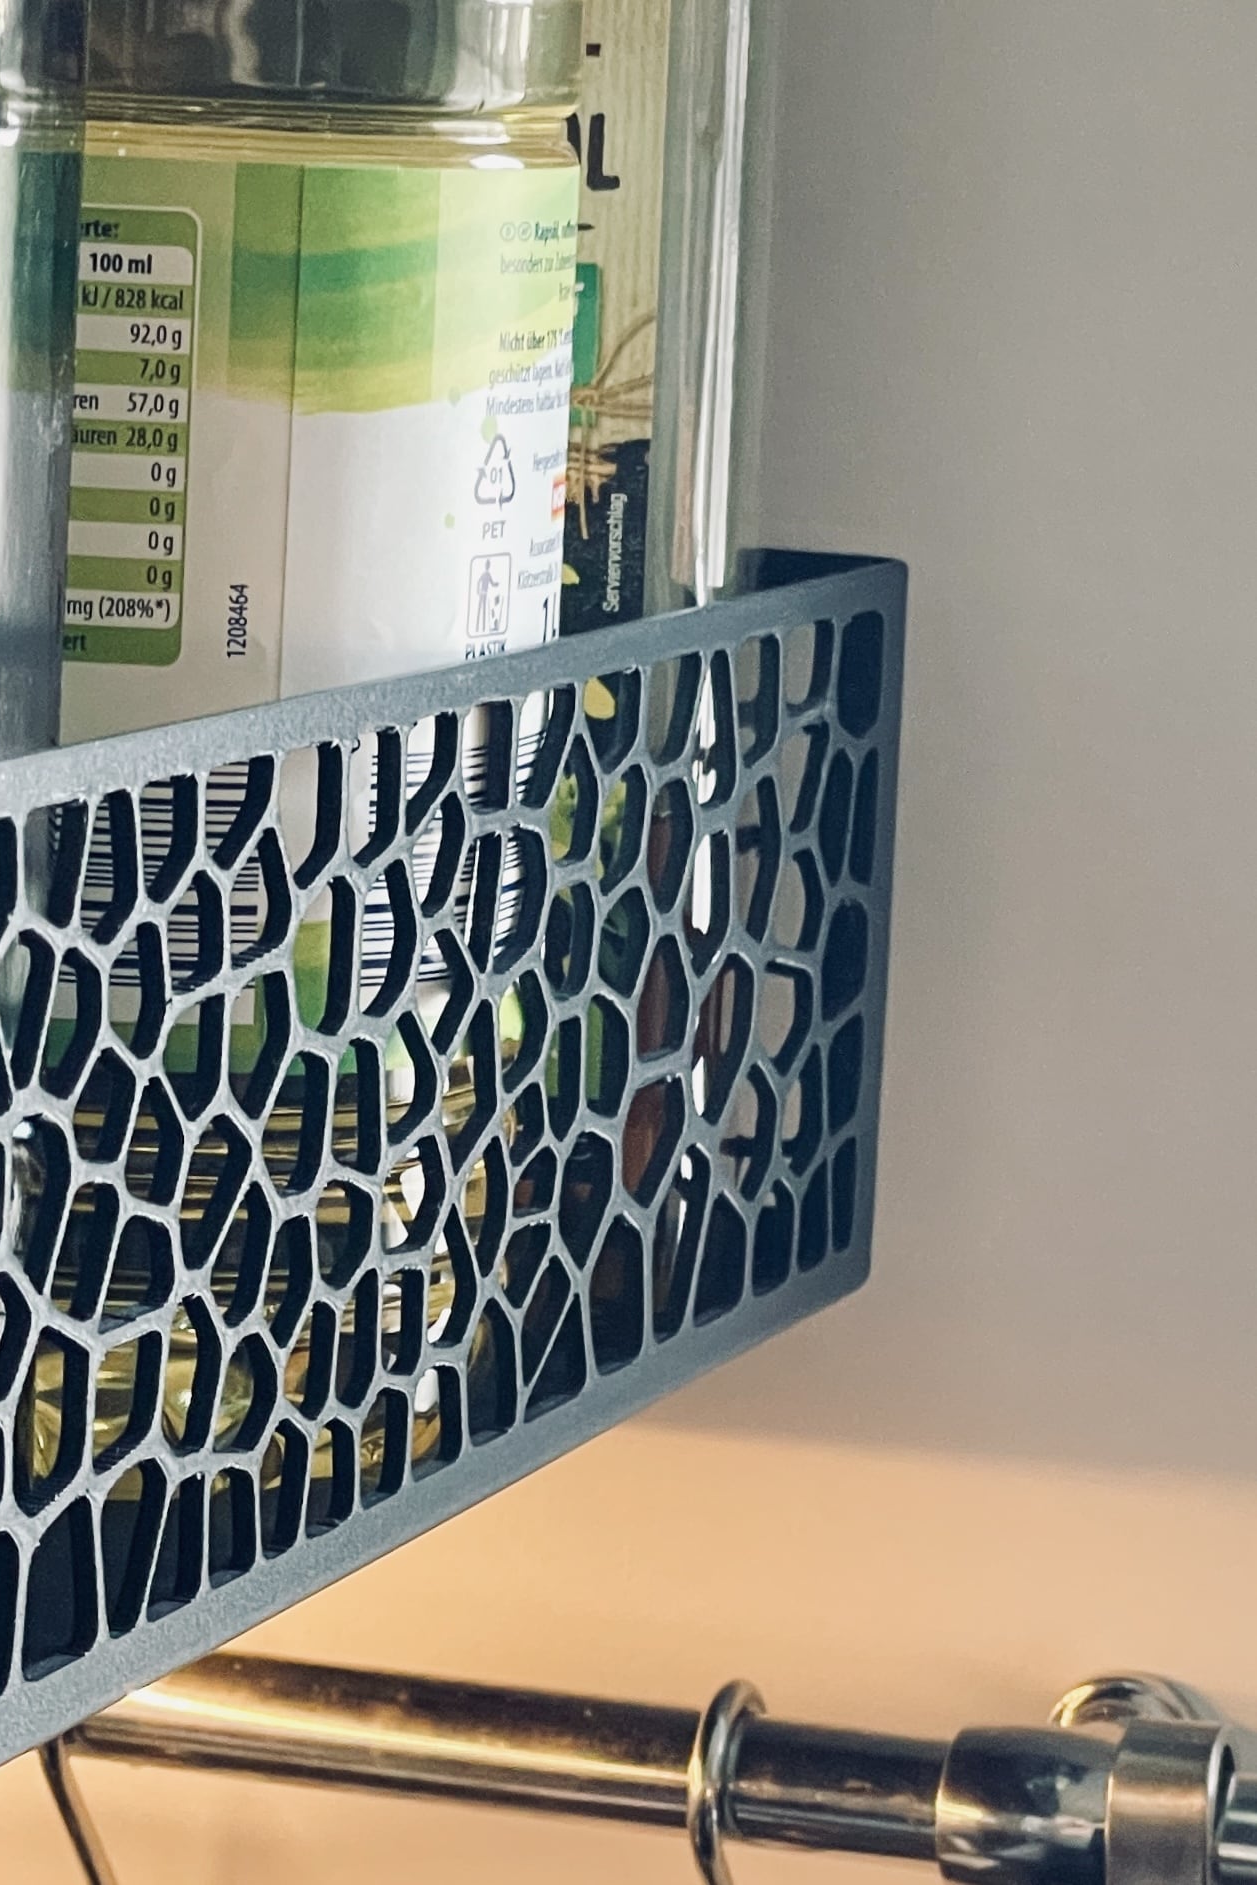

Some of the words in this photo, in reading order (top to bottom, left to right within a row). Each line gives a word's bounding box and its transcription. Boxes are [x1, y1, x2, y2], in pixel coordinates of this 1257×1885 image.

[80, 220, 119, 239] rte:
[89, 252, 123, 274] 100
[127, 253, 153, 275] ml
[81, 286, 98, 307] kJ
[101, 287, 111, 309] /
[115, 288, 146, 310] 828
[151, 289, 184, 311] kcal
[130, 323, 167, 347] 92,0
[172, 329, 182, 351] g
[140, 358, 166, 382] 7,0
[171, 363, 181, 386] g
[127, 392, 164, 416] 57,0
[169, 397, 179, 419] g
[126, 426, 163, 452] 28,0
[168, 432, 178, 453] g
[151, 462, 162, 482] 0
[166, 466, 177, 487] g
[490, 467, 503, 485] 01
[149, 497, 160, 517] 0
[164, 501, 175, 522] g
[482, 520, 506, 541] PET
[148, 531, 159, 551] 0
[163, 535, 174, 556] g
[602, 493, 628, 613] Serviervorschlag
[147, 565, 157, 585] 0
[161, 570, 173, 591] g
[67, 599, 93, 621] mg
[226, 583, 249, 659] 1208464
